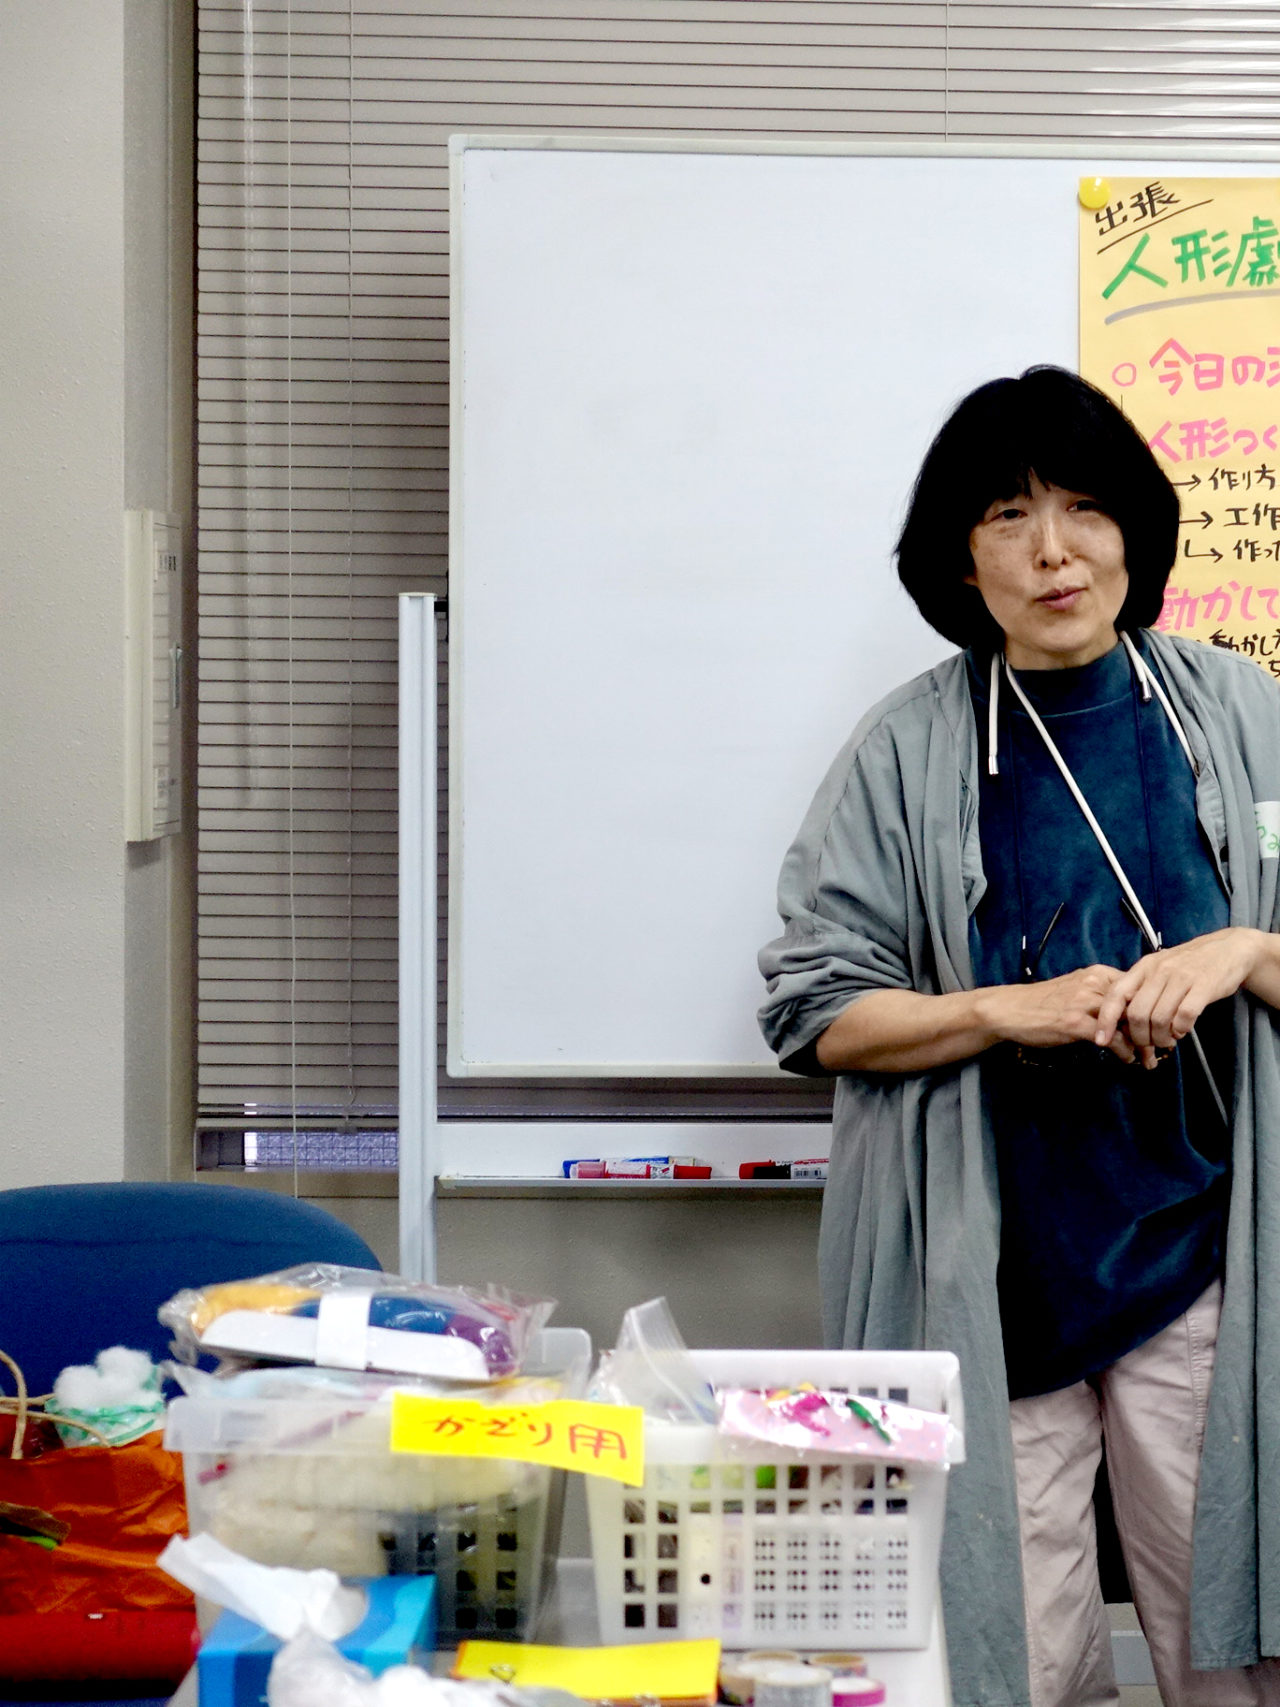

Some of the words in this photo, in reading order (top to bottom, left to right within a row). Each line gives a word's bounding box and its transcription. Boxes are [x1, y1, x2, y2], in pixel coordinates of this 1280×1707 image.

[1095, 181, 1180, 236] 出張
[422, 1411, 628, 1461] かざり用
